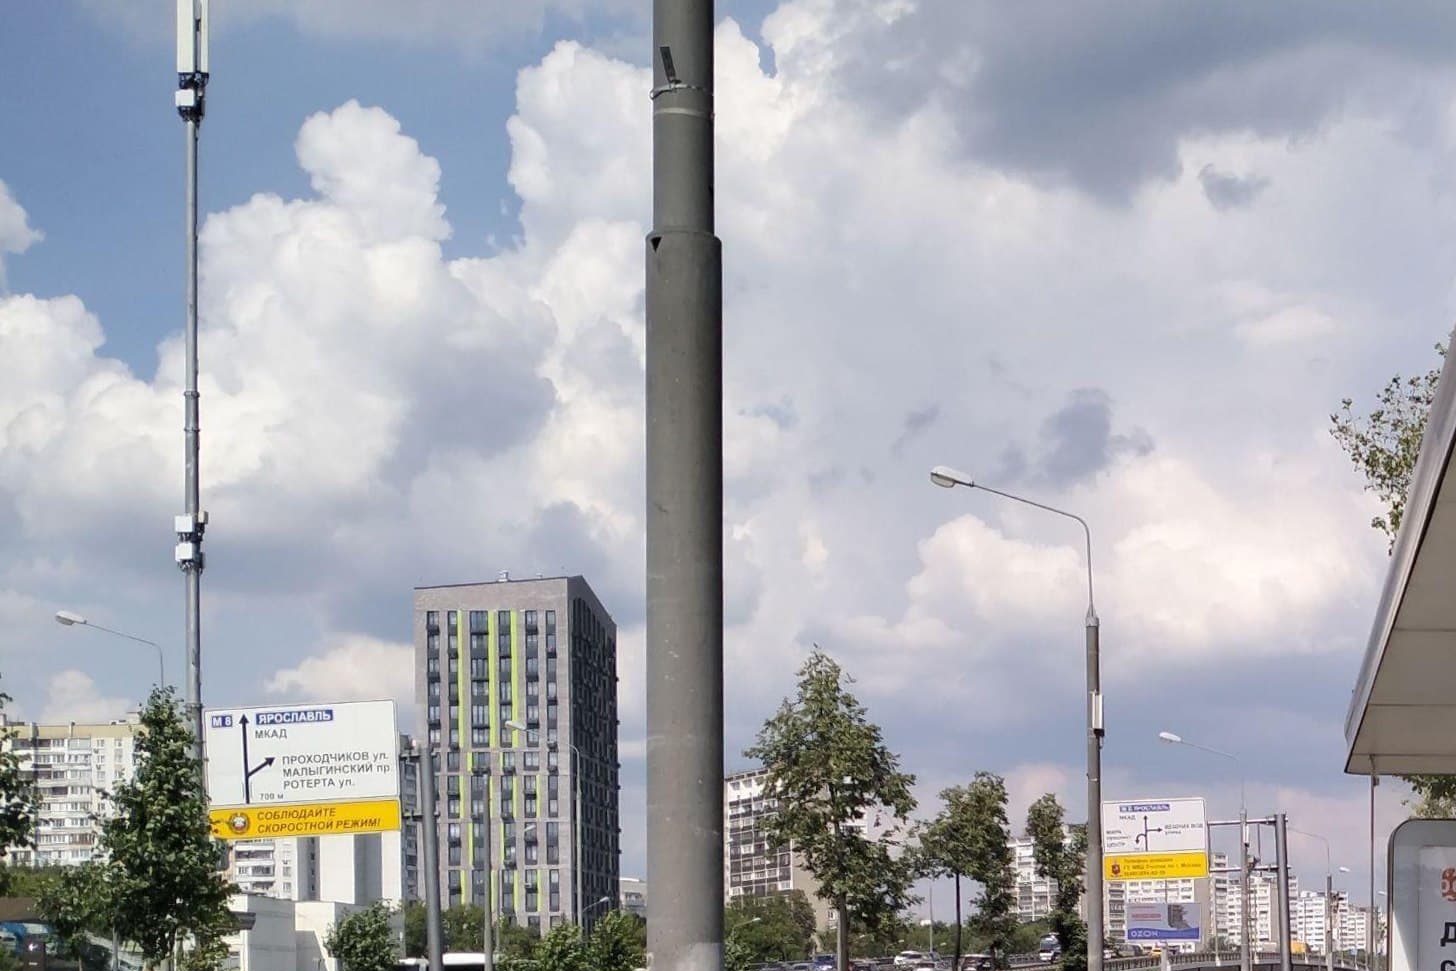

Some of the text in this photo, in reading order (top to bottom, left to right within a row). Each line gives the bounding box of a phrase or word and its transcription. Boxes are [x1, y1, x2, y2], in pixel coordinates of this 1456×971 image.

[258, 711, 332, 725] ЯРОСЛАВЛЬ
[255, 728, 288, 739] МКАД
[282, 752, 389, 765] ПРОХОДЧИКОВ ул.
[283, 762, 373, 777] МАЛЫГИНСКИЙ
[283, 778, 335, 790] РОТЕРТА
[257, 807, 337, 820] СОБЛЮДАЙТЕ
[257, 817, 381, 834] СКОРОСТНОЙ РЕЖИМ!
[1130, 930, 1158, 938] OZON
